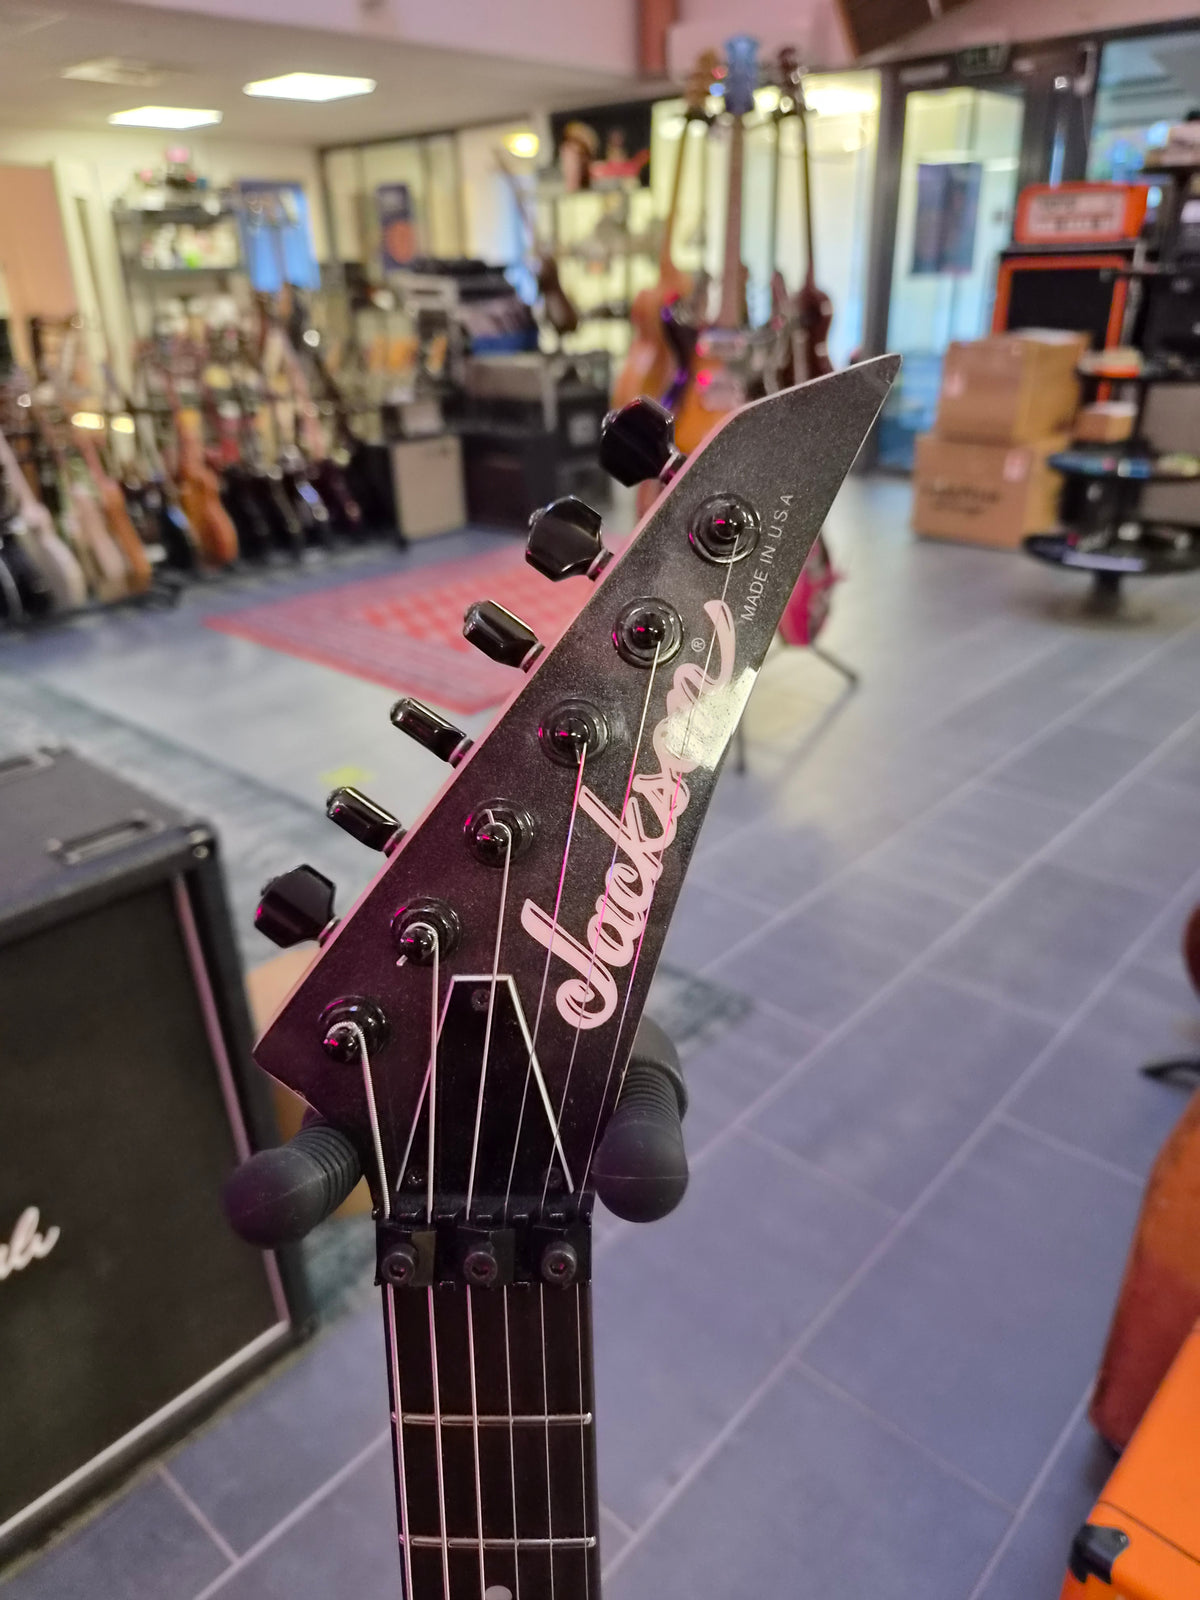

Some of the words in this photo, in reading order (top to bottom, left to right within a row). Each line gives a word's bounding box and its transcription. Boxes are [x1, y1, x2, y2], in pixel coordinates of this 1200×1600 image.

[741, 569, 769, 621] MADE
[760, 545, 777, 565] IN
[521, 600, 736, 1029] Jackson
